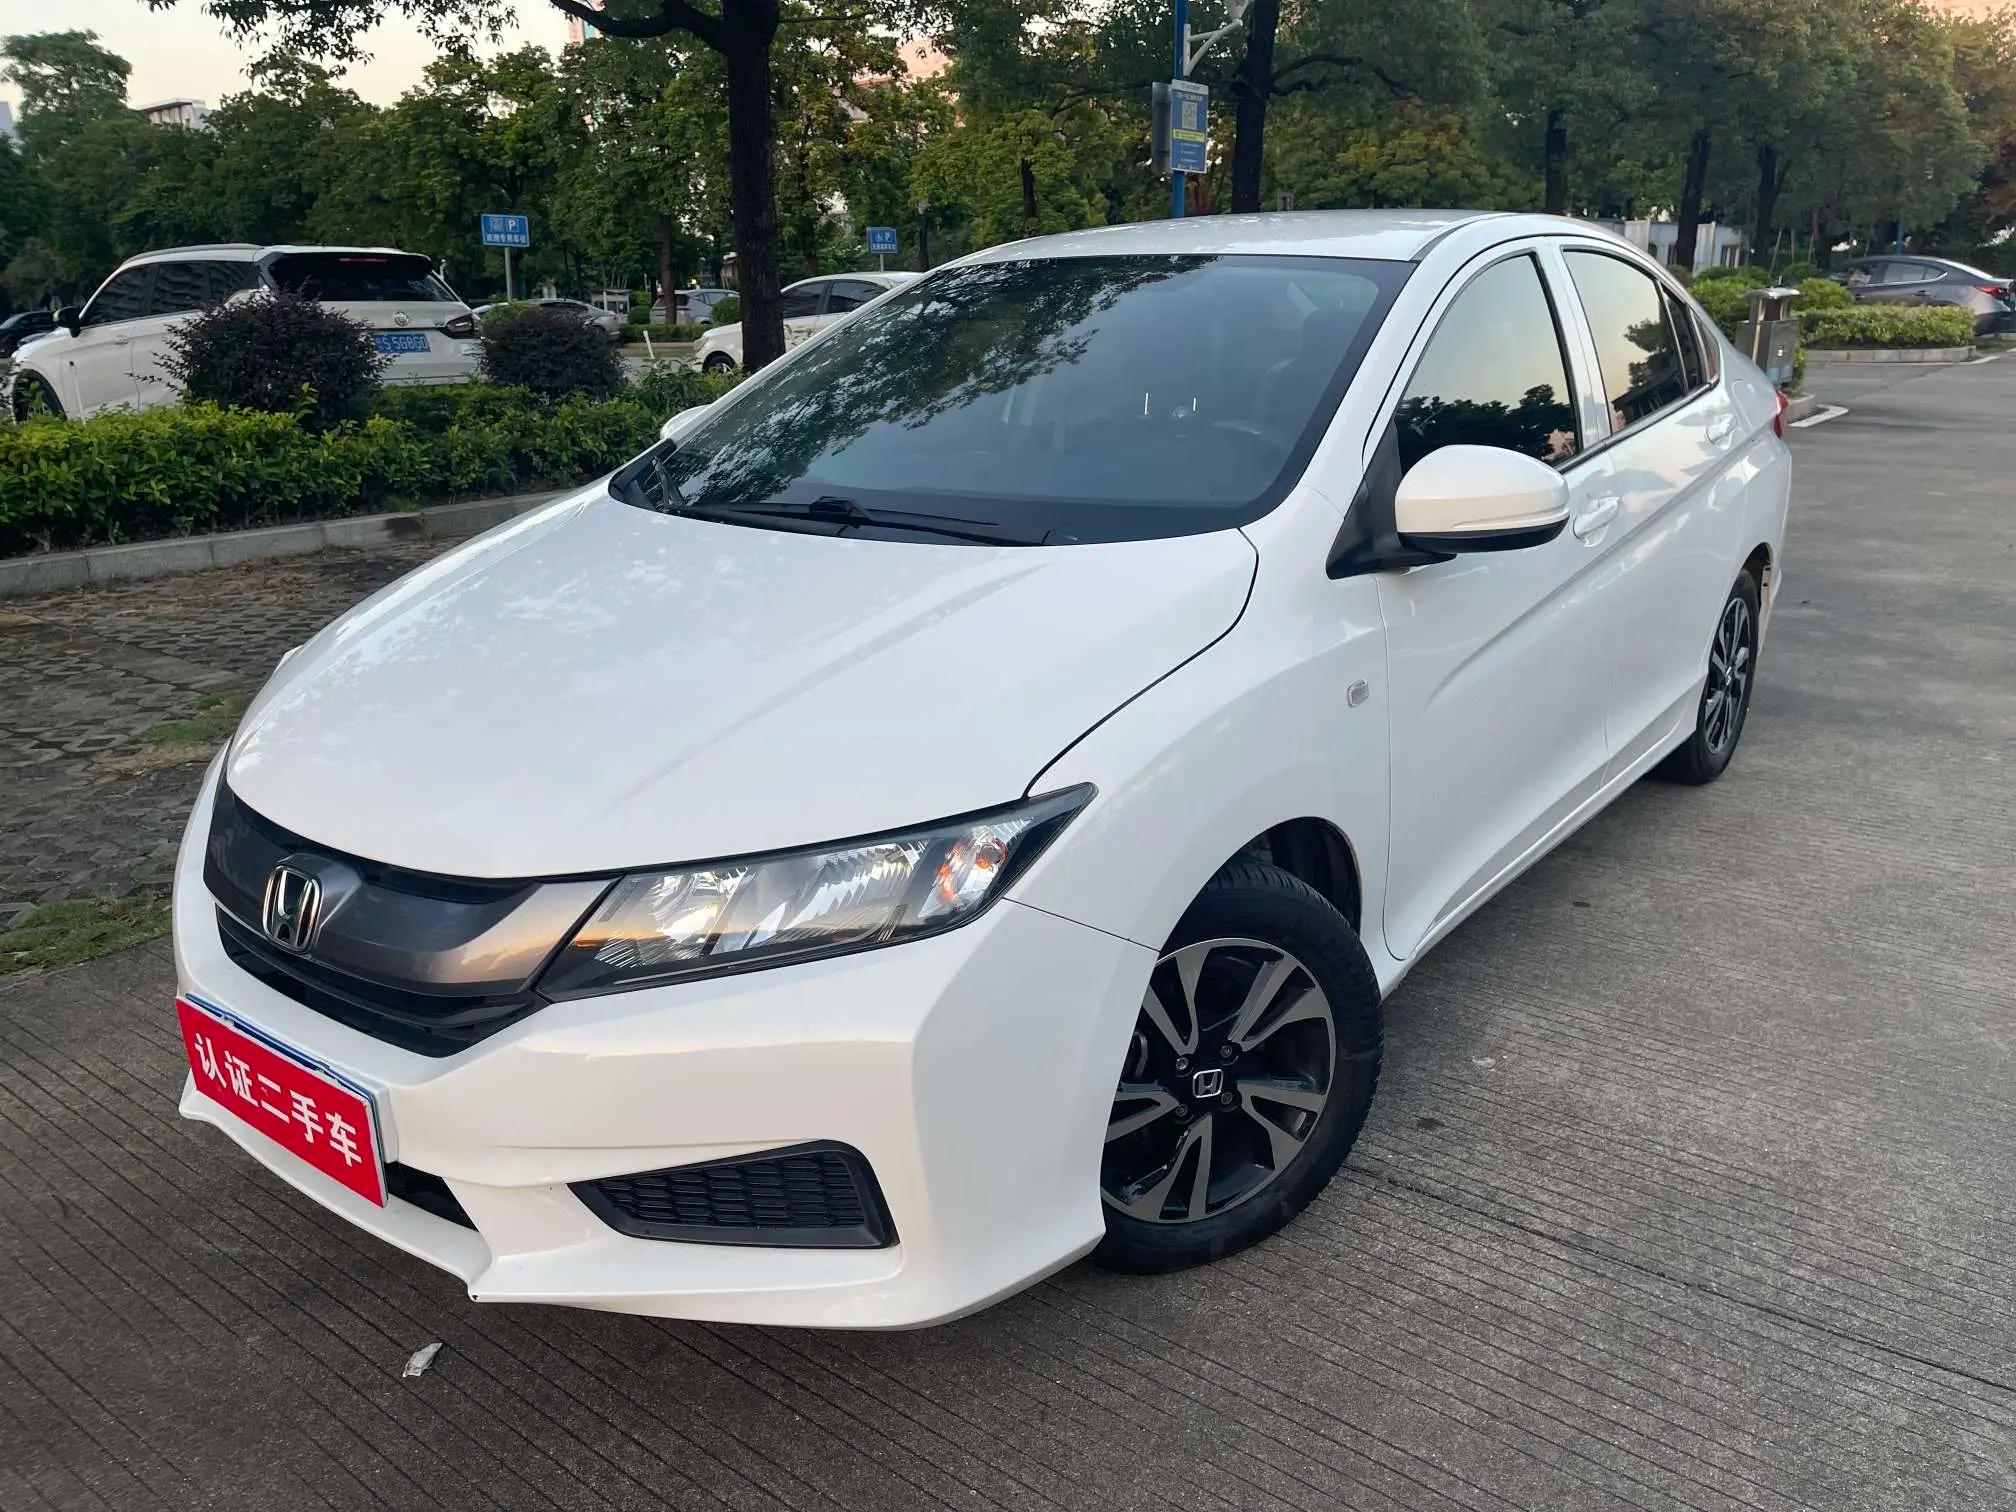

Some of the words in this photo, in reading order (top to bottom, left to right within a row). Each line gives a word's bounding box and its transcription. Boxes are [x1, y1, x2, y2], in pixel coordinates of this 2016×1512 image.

[507, 219, 516, 231] P
[195, 1033, 361, 1166] 认证二手车
